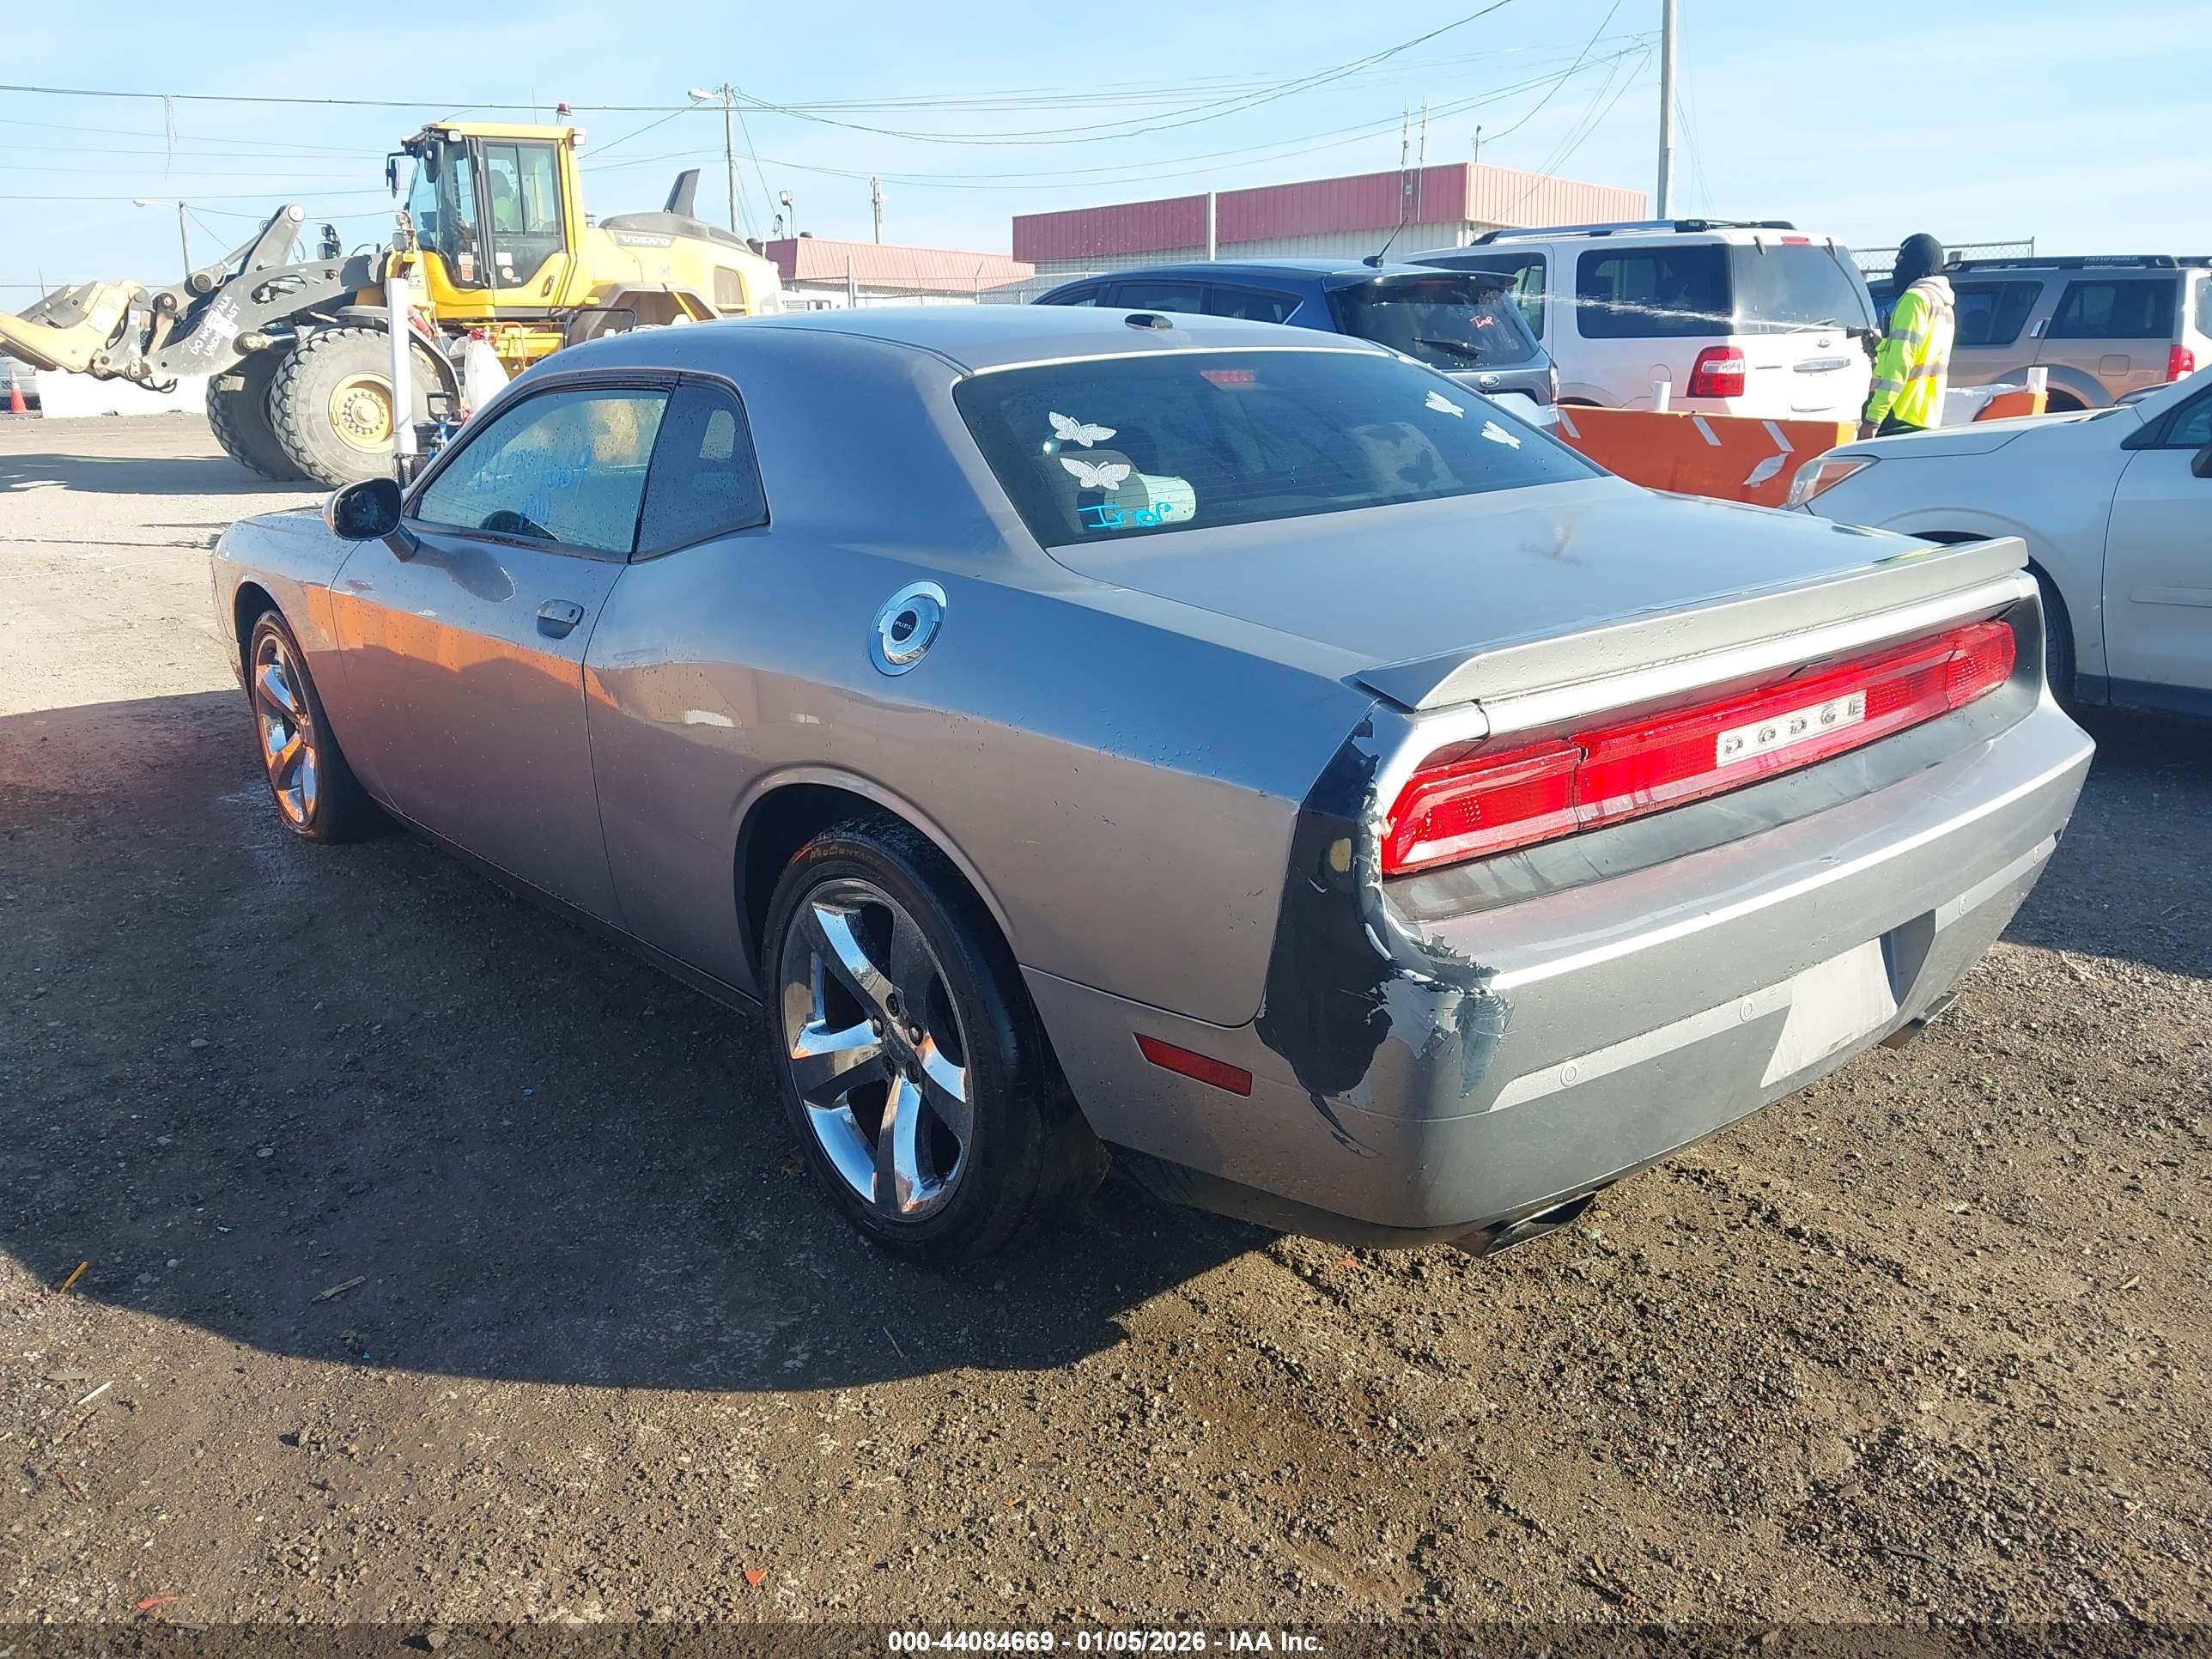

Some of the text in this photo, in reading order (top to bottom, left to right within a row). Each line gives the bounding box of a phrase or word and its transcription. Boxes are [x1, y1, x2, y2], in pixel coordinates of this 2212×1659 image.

[620, 235, 672, 246] VOLVO
[190, 340, 204, 355] DO
[1724, 698, 1863, 756] DODGE
